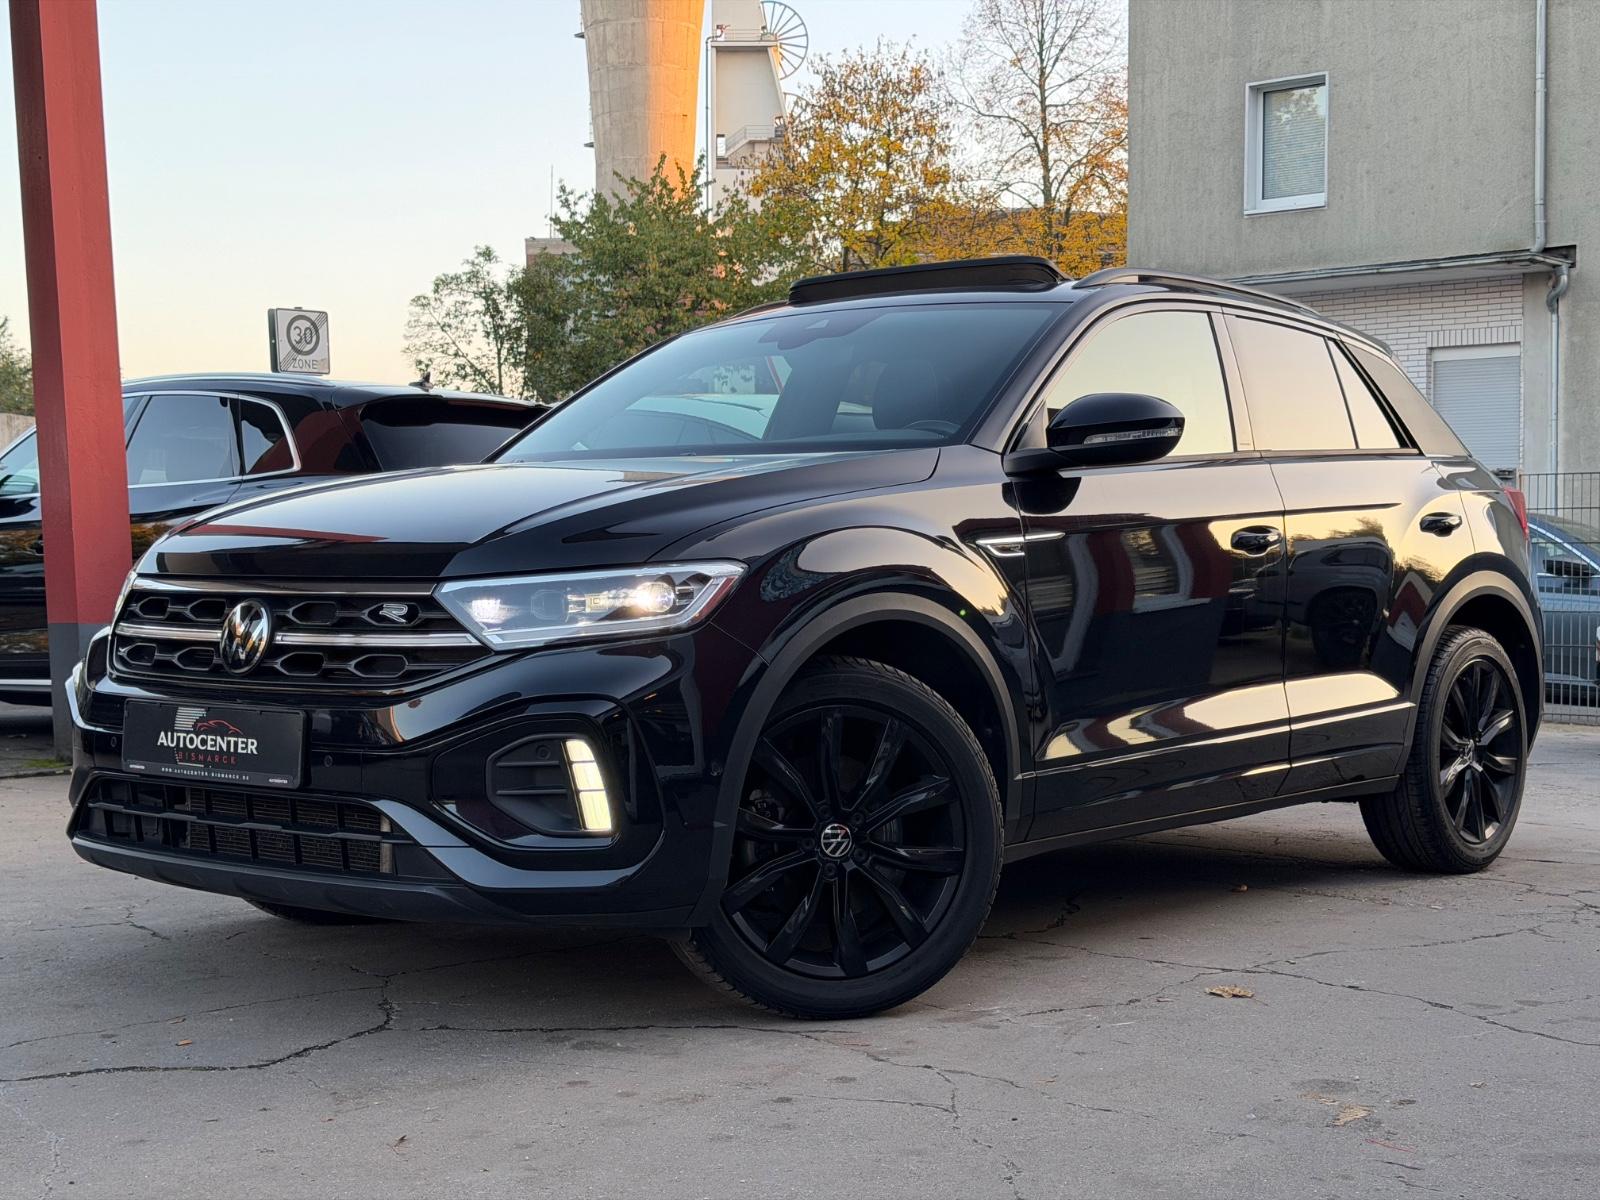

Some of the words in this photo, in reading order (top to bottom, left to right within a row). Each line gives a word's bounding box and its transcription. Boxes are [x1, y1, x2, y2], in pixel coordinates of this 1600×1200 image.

[293, 326, 313, 345] 30
[292, 358, 320, 370] ZONE
[157, 731, 258, 755] AUTOCENTER
[177, 751, 237, 765] BISMARCK
